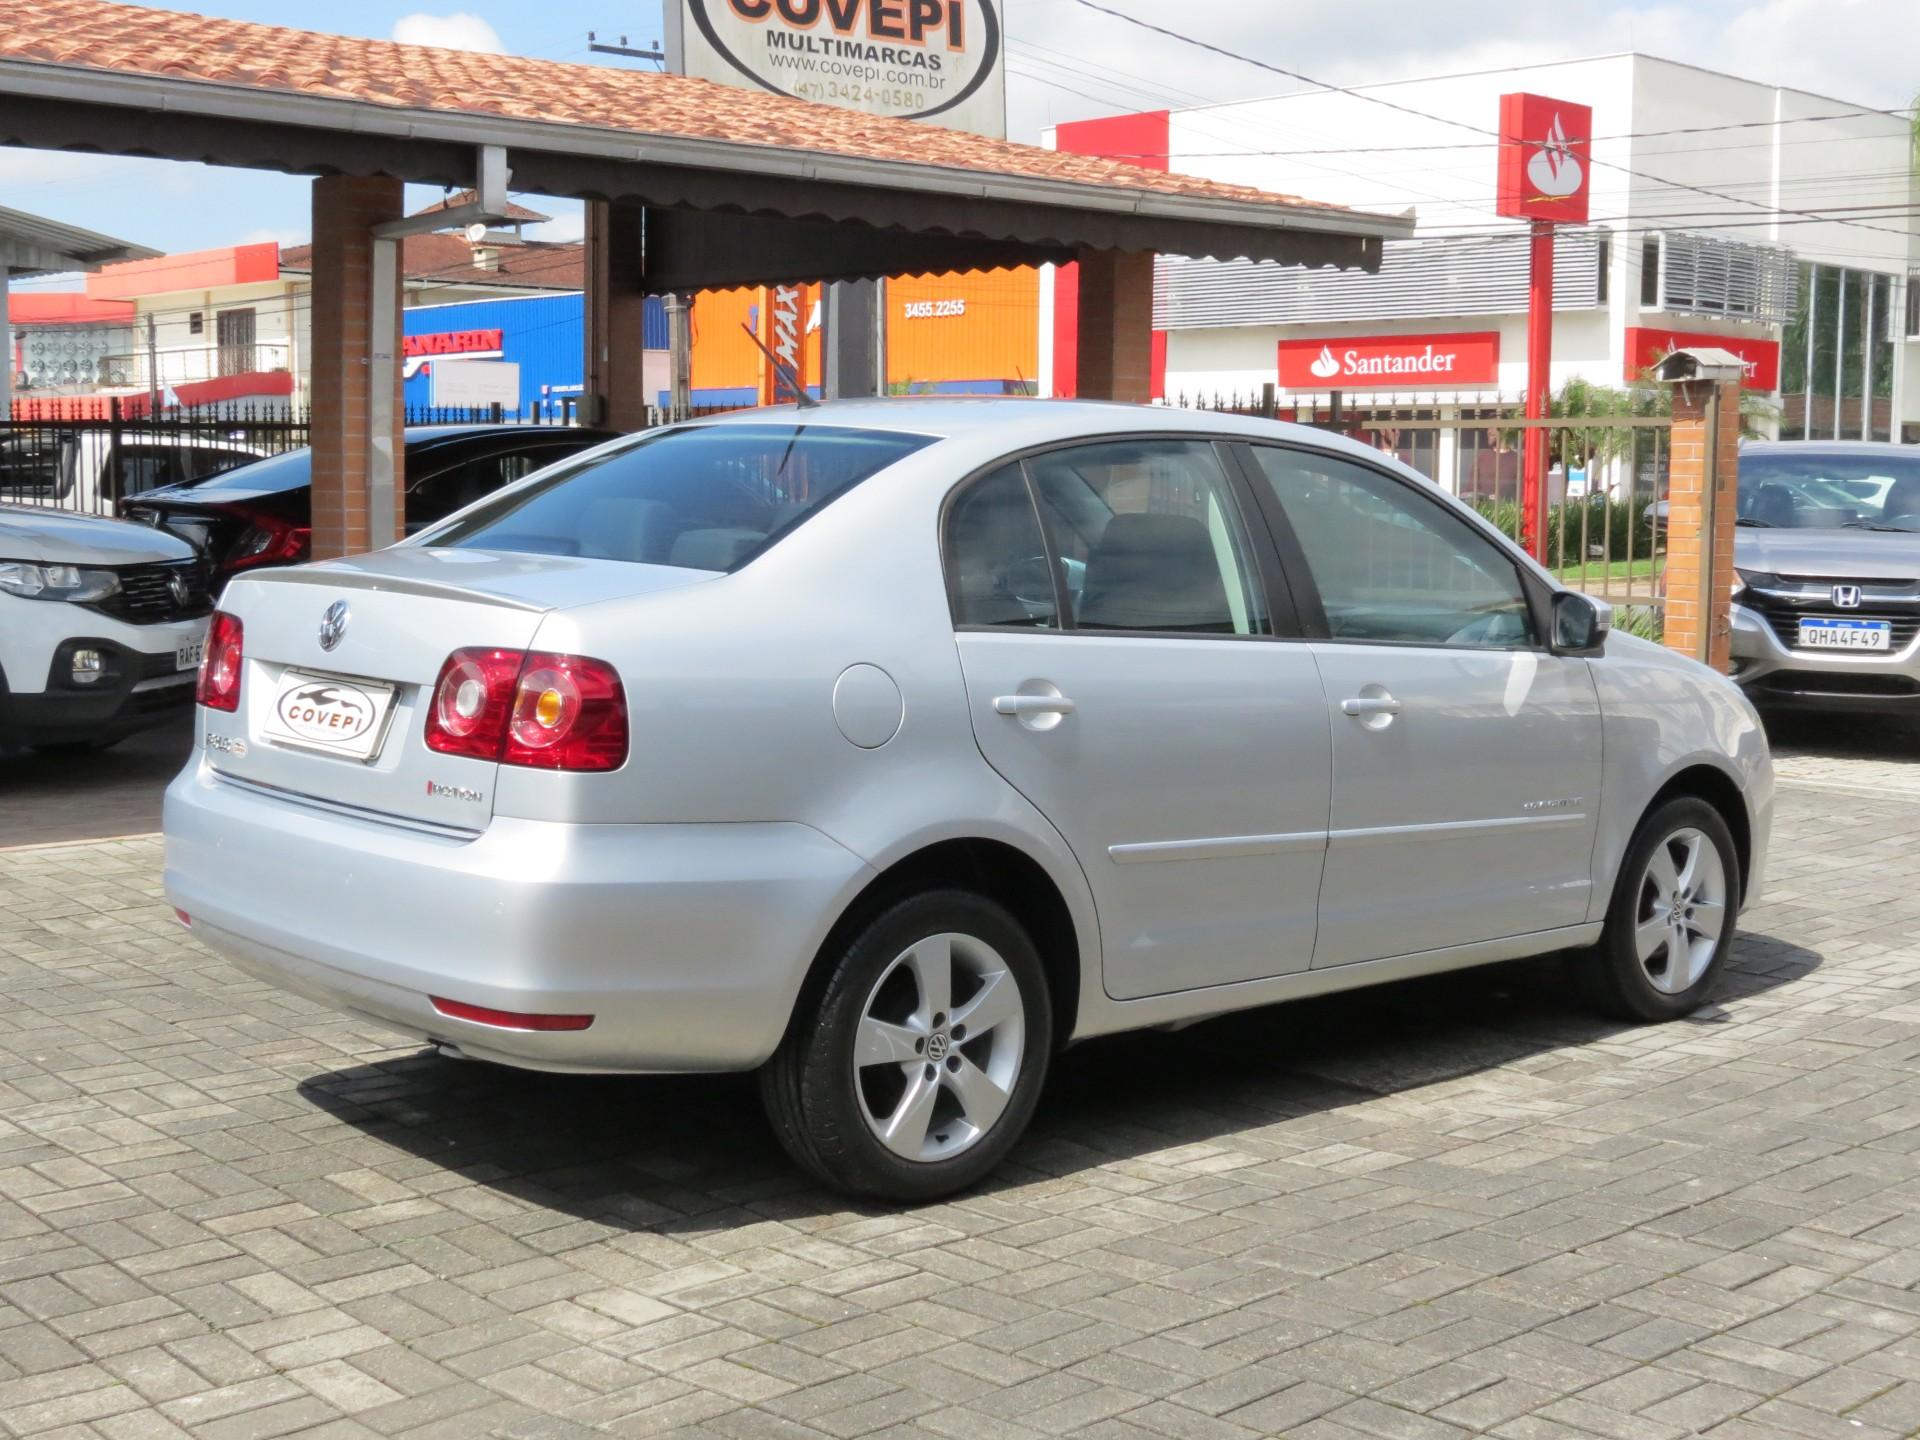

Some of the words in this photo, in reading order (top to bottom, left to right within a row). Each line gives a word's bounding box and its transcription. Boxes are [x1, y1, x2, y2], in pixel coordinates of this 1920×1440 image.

[766, 30, 941, 71] MULTIMARCAS
[769, 53, 946, 89] www.covepi.com.br
[828, 81, 925, 110] 3424-0580
[904, 300, 965, 318] 3455.2255
[775, 285, 799, 369] MAX
[1343, 345, 1456, 376] Santander
[1809, 629, 1880, 647] QHA4F49
[288, 705, 363, 731] COVEPI
